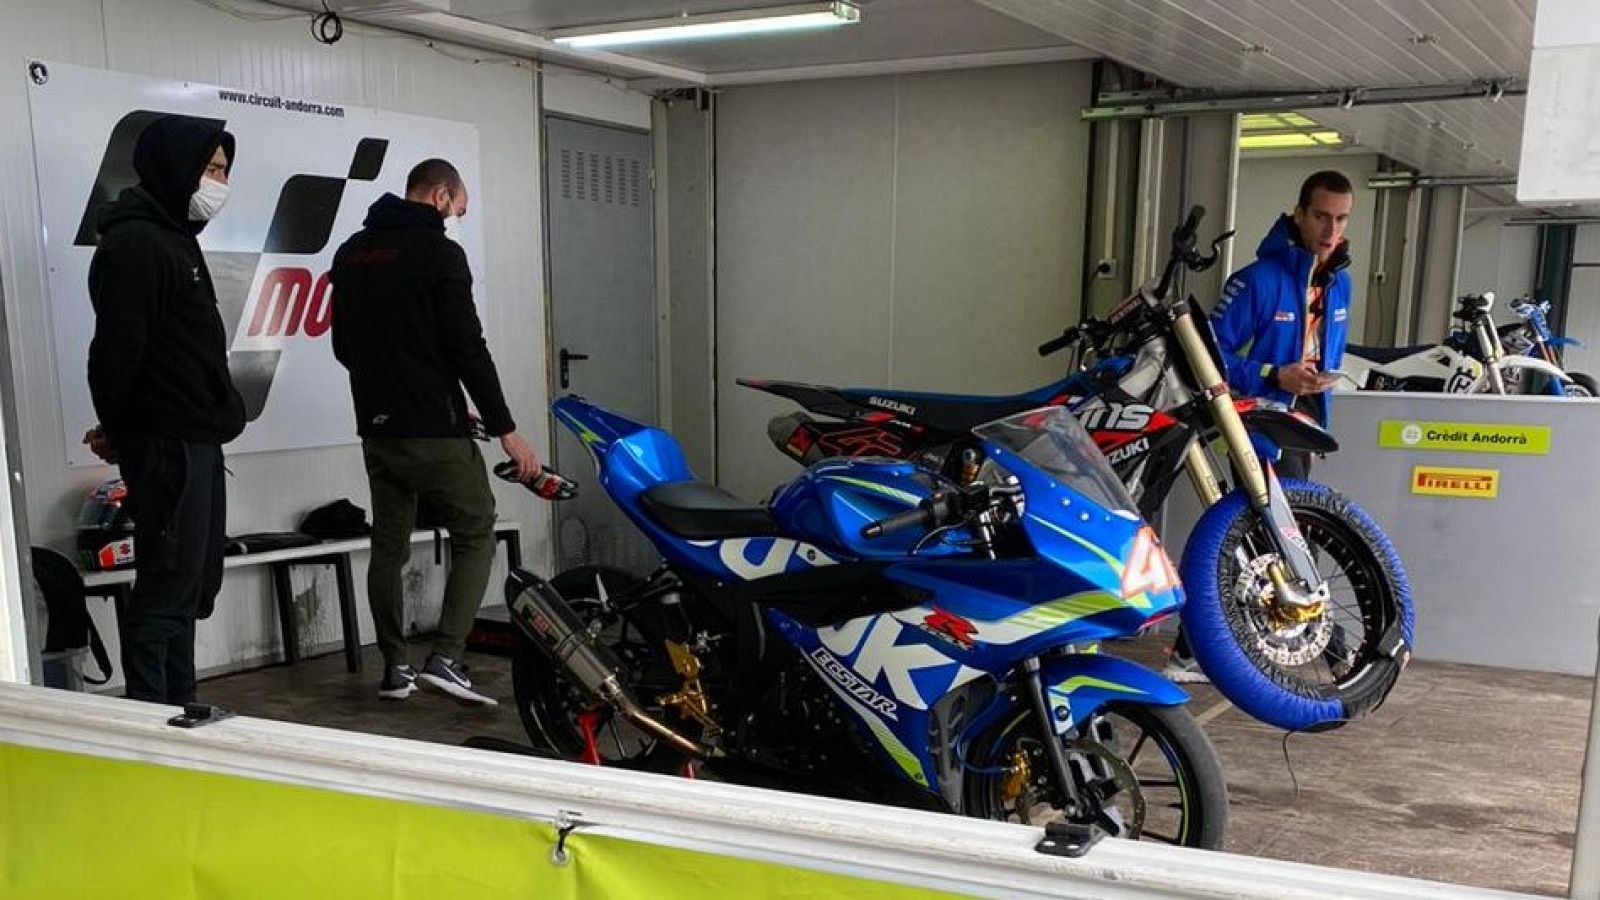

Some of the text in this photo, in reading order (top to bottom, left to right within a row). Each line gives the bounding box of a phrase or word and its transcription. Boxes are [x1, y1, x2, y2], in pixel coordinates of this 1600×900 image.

[219, 90, 345, 117] www.circuit-andorra.com
[868, 396, 916, 415] SUZUKI
[1109, 436, 1151, 465] ZUKI
[1417, 471, 1493, 491] PIRELLI
[811, 647, 899, 722] ECSTAR
